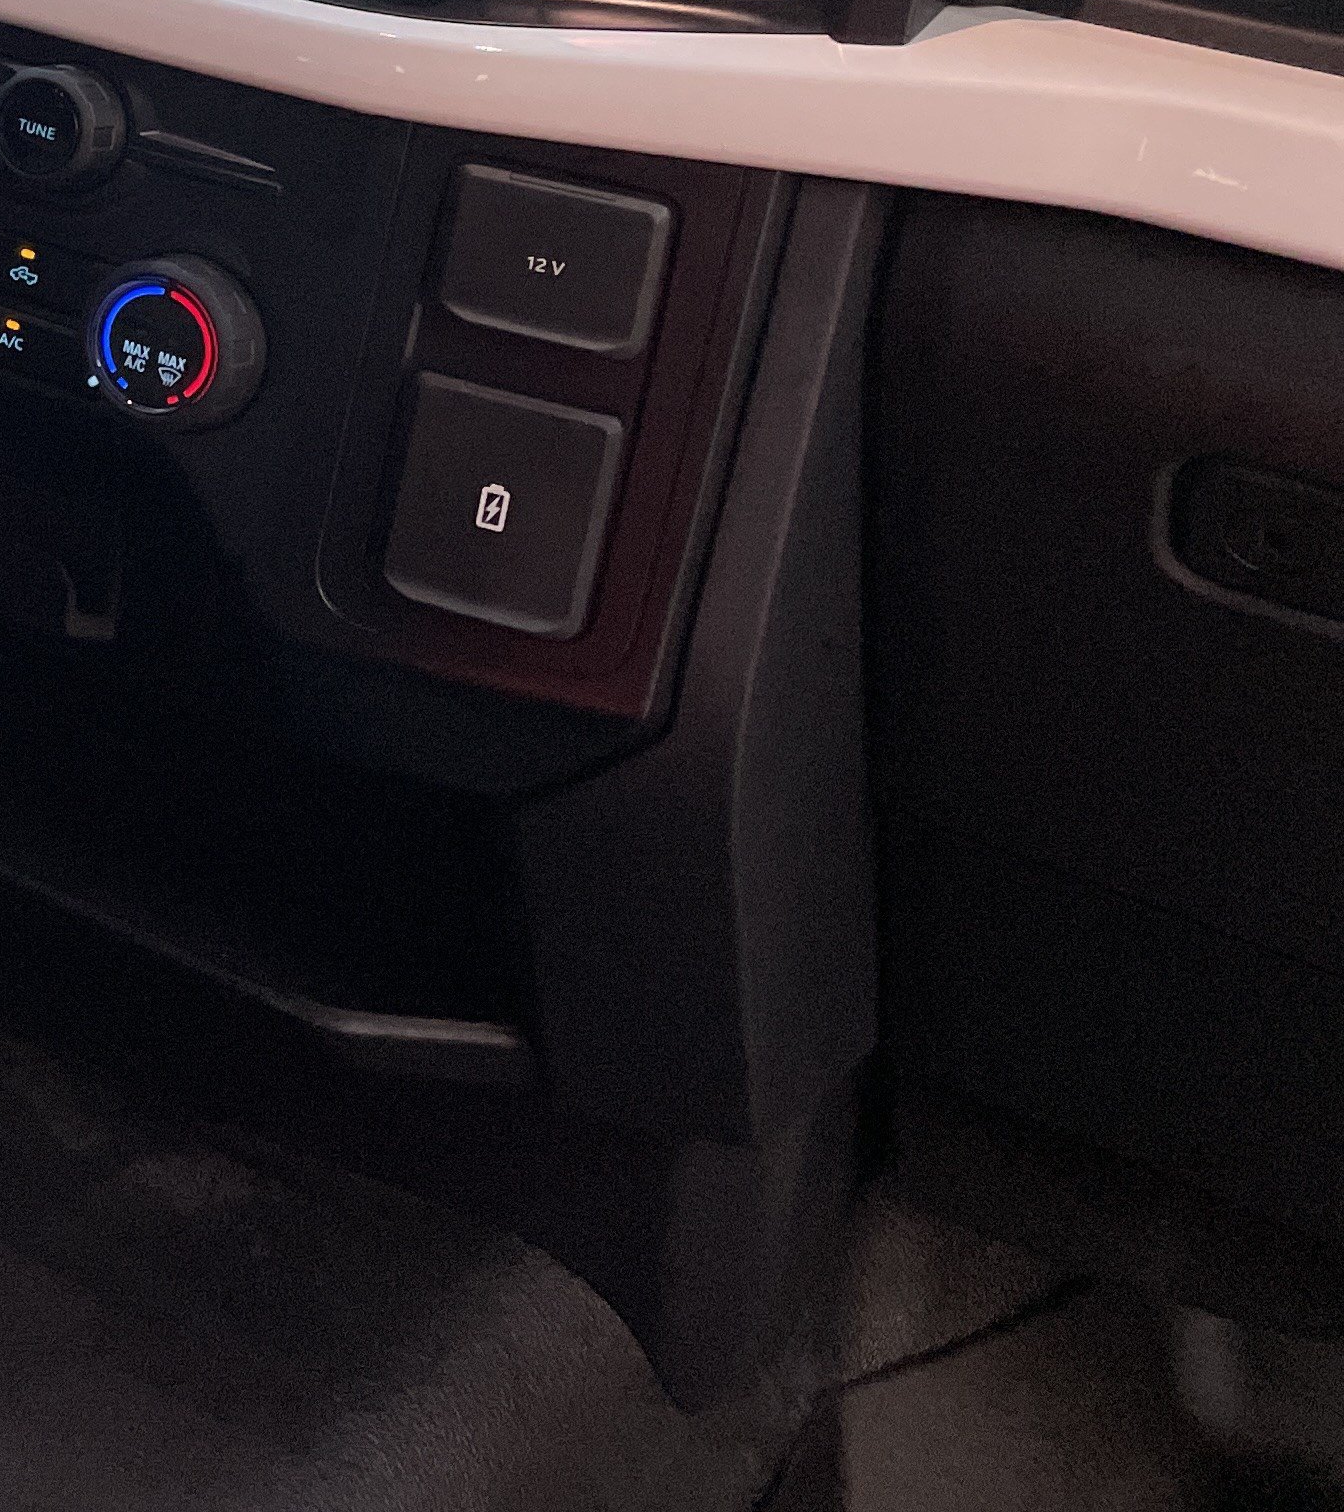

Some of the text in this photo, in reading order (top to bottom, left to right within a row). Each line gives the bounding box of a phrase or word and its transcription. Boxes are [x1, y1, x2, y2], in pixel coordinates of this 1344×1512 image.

[17, 116, 58, 141] TUNE
[526, 255, 566, 277] 12 V
[122, 339, 187, 373] MAX MAX
[123, 355, 147, 374] A/C
